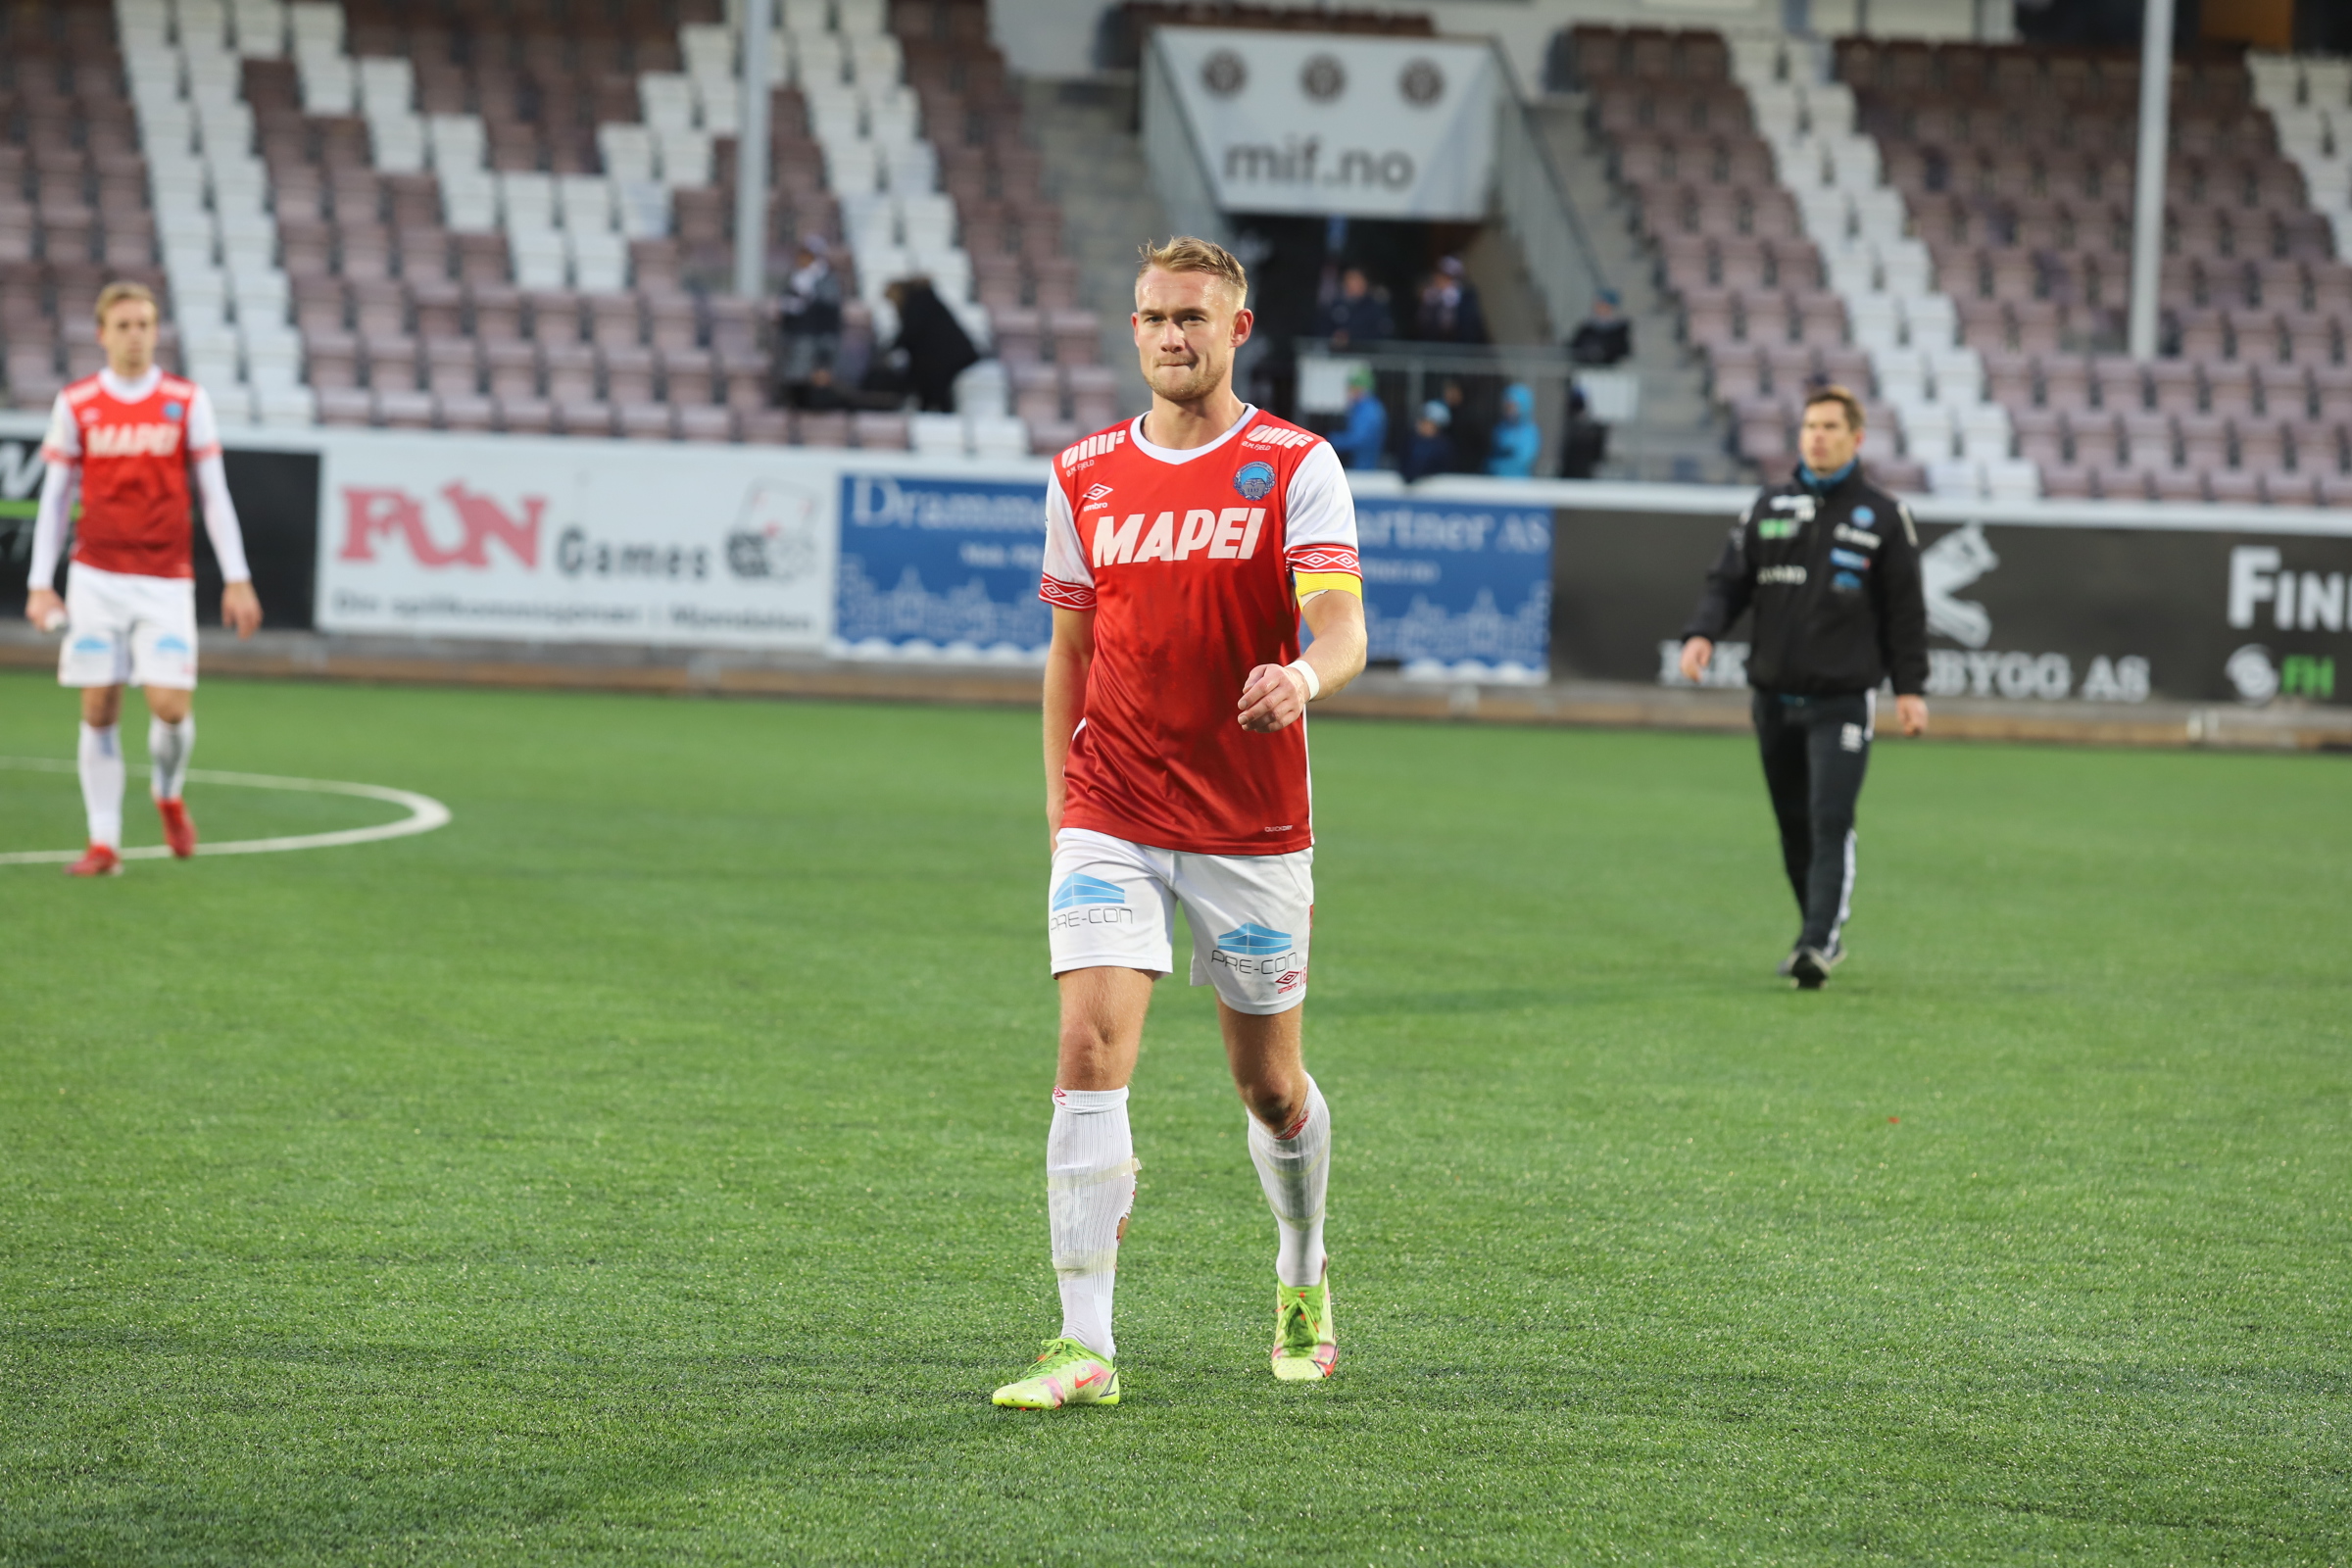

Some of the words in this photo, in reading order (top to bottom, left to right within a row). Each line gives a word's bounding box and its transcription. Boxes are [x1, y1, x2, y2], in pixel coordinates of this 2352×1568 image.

[1224, 131, 1415, 193] mif.no
[85, 423, 181, 458] MAPEI
[1077, 459, 1095, 471] FJELD
[338, 479, 547, 572] FUN
[1083, 502, 1108, 512] umbro
[557, 525, 710, 577] Games
[1092, 508, 1266, 568] MAPEI
[1357, 507, 1496, 552] artner
[1495, 513, 1551, 555] AS
[2227, 545, 2352, 634] FIN
[1926, 648, 2071, 701] BYGG
[2081, 655, 2151, 704] AS
[2280, 655, 2336, 700] FH
[1050, 907, 1133, 933] PRE-CON
[1211, 949, 1298, 975] PRE-CON
[1277, 983, 1298, 995] umbro
